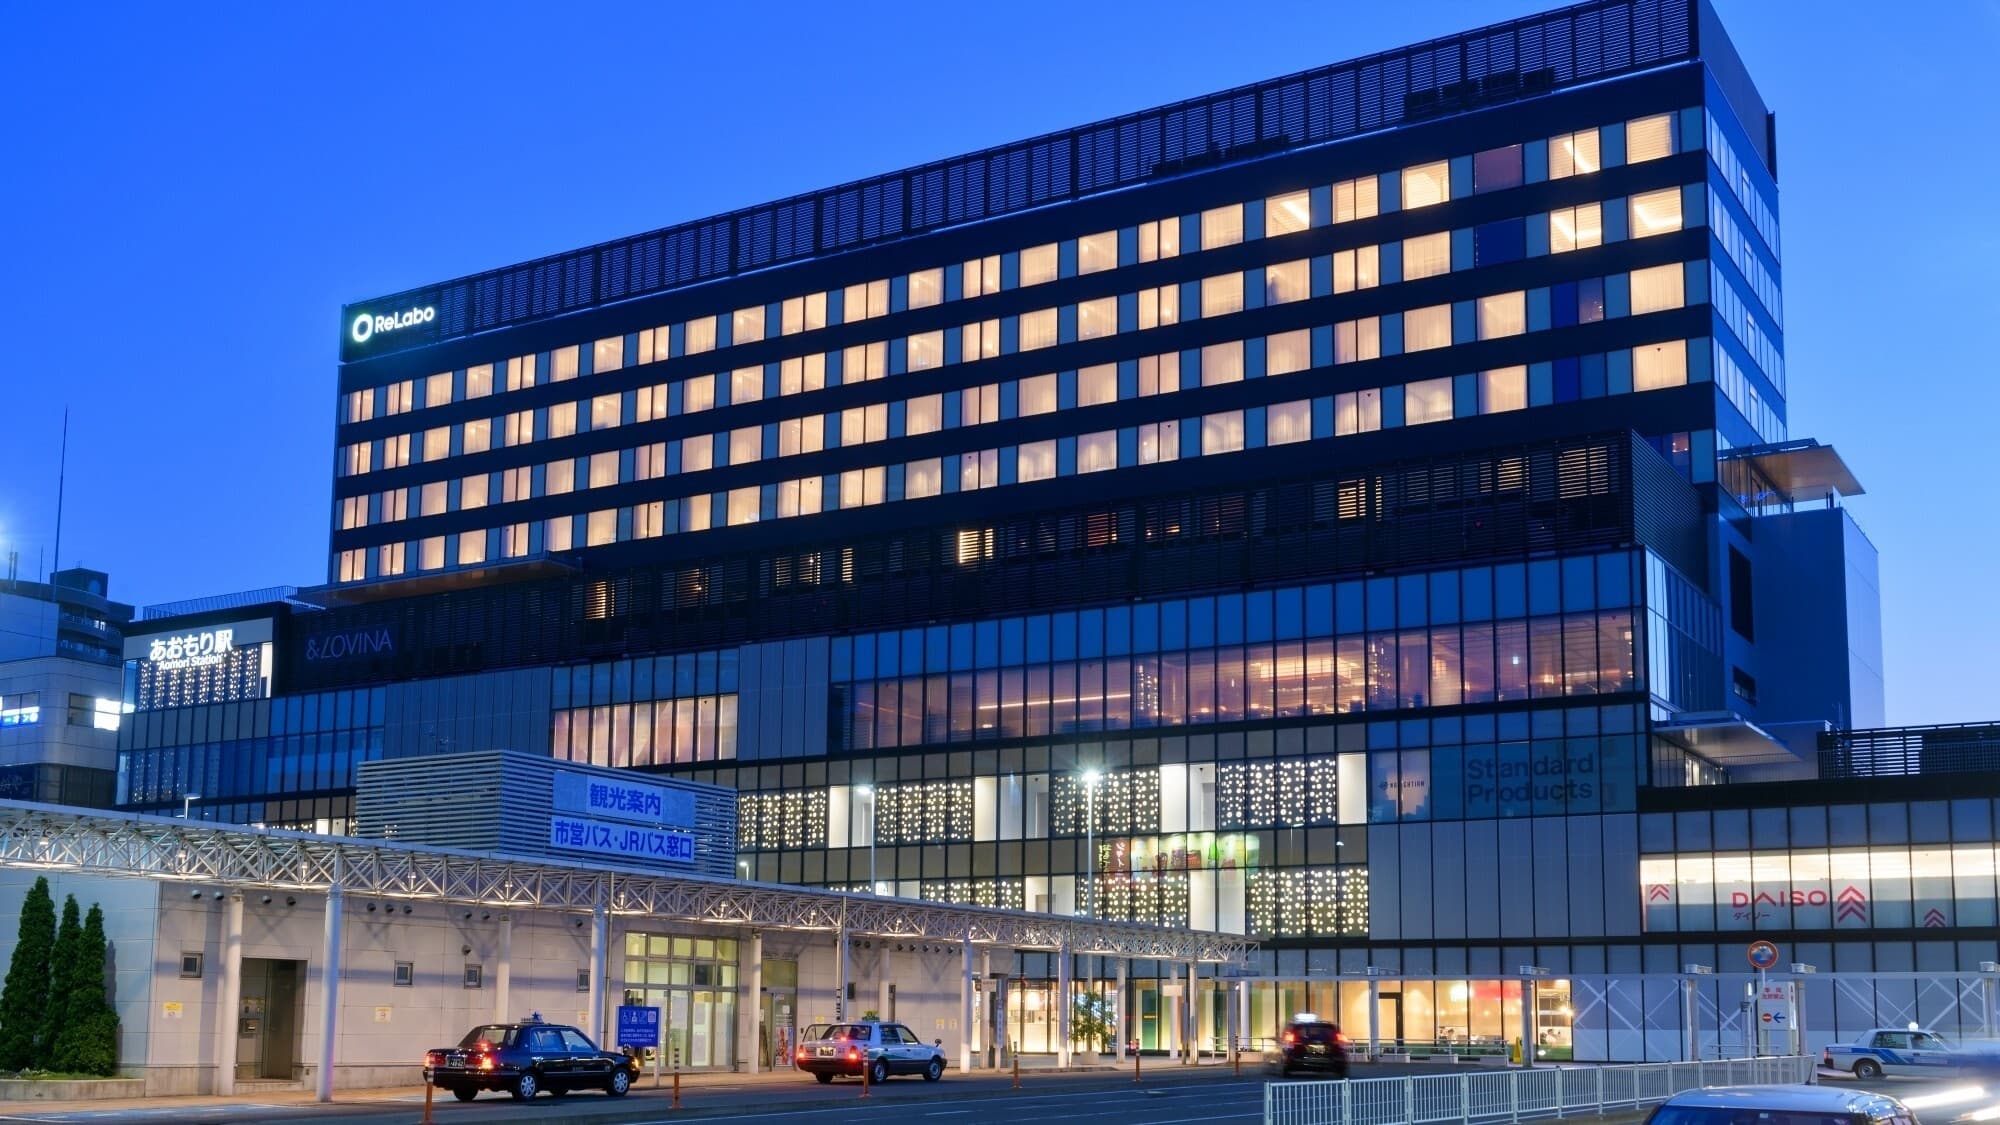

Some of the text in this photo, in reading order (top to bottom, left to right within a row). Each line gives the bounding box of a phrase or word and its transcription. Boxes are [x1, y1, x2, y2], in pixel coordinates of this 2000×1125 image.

[375, 306, 435, 333] ReLabo
[149, 629, 233, 661] あおもり駅
[159, 653, 222, 670] Aomori Station
[1467, 752, 1594, 779] Standard
[589, 783, 661, 816] 観光案内
[1467, 780, 1593, 803] Products
[555, 820, 692, 859] 市営バス・JRバス窓口
[1732, 890, 1827, 908] DAISO
